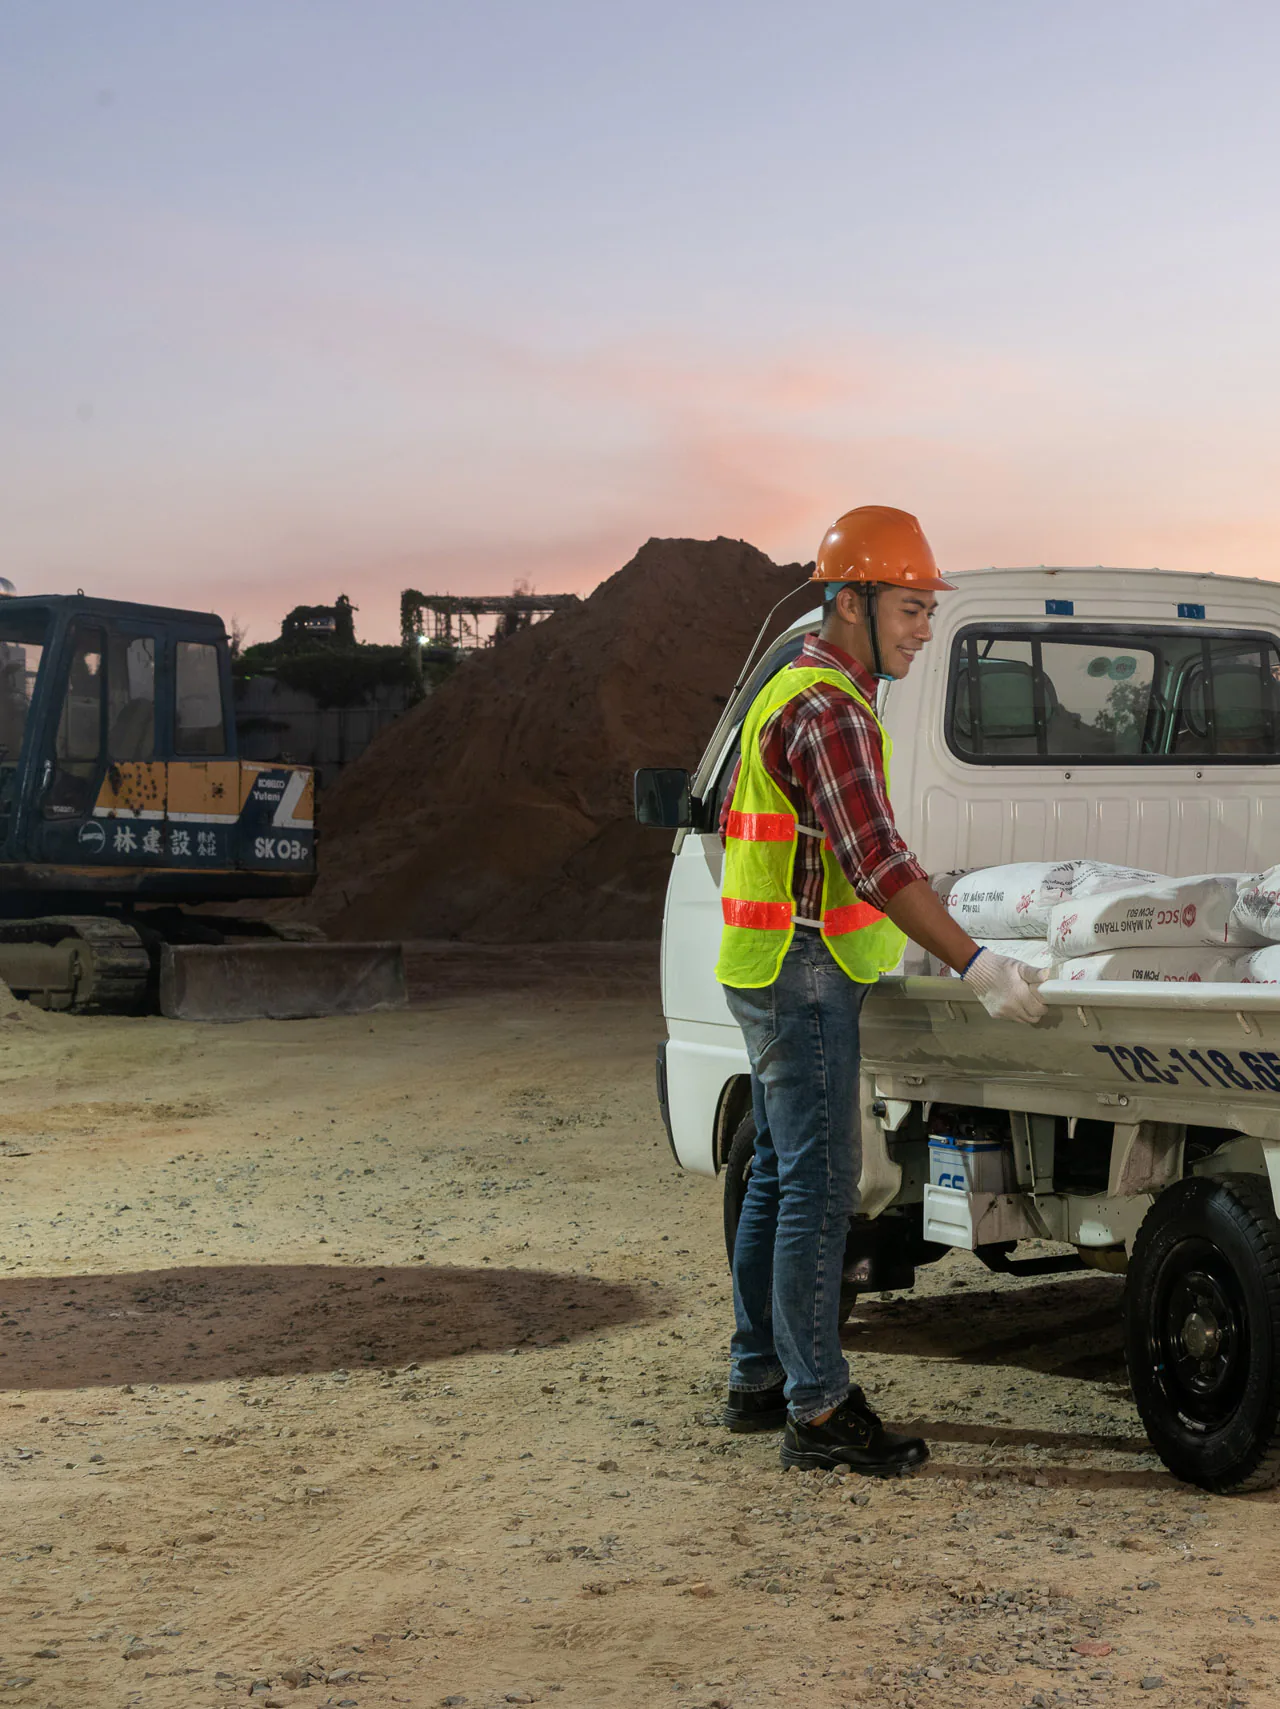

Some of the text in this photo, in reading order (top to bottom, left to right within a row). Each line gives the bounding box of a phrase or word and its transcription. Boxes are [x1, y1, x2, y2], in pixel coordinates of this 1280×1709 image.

[941, 894, 958, 907] SCG
[1157, 909, 1180, 925] SCG
[1145, 919, 1153, 931] XI
